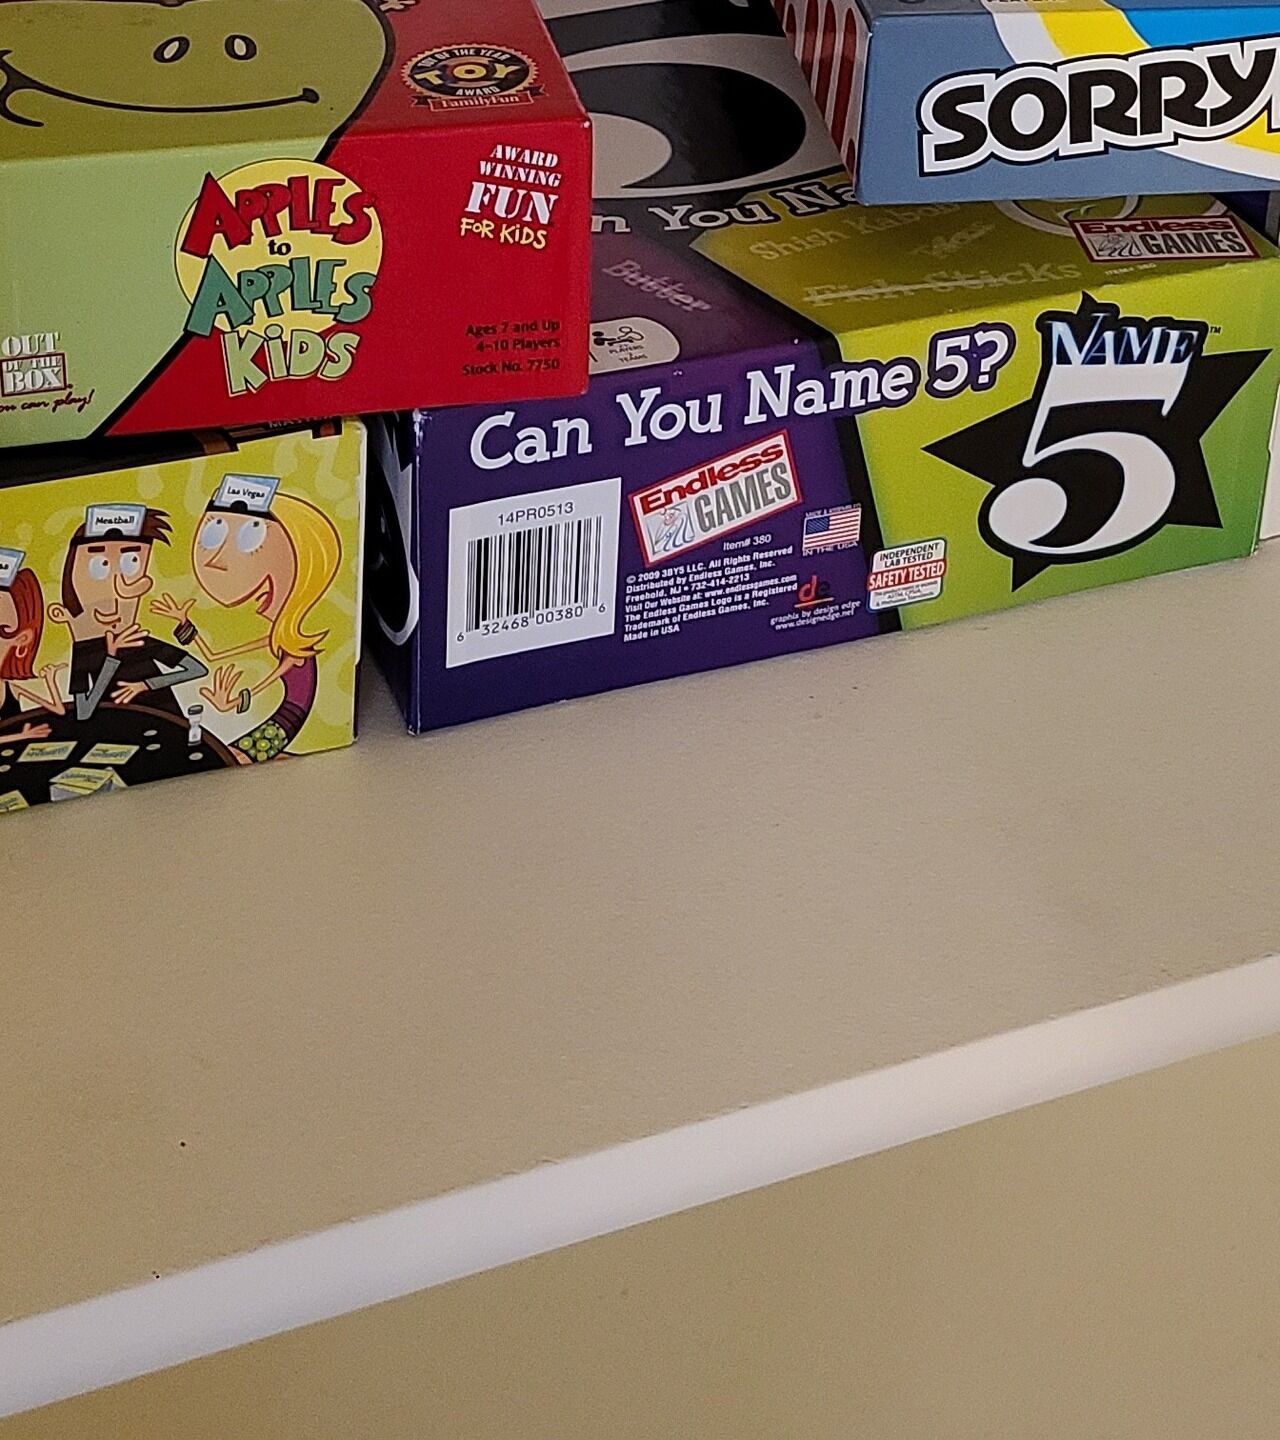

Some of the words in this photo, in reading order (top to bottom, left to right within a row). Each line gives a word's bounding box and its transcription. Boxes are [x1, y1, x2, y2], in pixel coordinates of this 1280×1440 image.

[452, 48, 477, 57] THE
[413, 62, 522, 86] TOY
[440, 95, 521, 109] FamilyFun
[455, 85, 501, 97] AWARD
[489, 144, 559, 169] AWARD
[478, 160, 563, 188] WINNING
[179, 171, 378, 259] APPLES
[464, 180, 560, 226] FUN
[647, 203, 779, 233] You
[1078, 218, 1235, 235] Endless
[267, 239, 292, 256] to
[748, 227, 850, 261] Shish
[1138, 231, 1248, 256] GAMES
[183, 253, 378, 337] APPLES
[465, 323, 498, 339] Ages
[512, 319, 539, 333] and
[541, 318, 561, 334] Up
[1048, 311, 1199, 367] NAME
[0, 331, 61, 357] OUT
[511, 337, 561, 352] Players
[3, 367, 62, 394] BOX
[461, 362, 498, 377] Stock
[20, 400, 50, 411] can
[468, 410, 595, 471] Can
[615, 387, 724, 448] You
[743, 361, 914, 427] Name
[932, 327, 1010, 392] 5?
[987, 362, 1191, 555] 5
[241, 486, 266, 500] Vegas
[639, 442, 786, 518] Endless
[693, 461, 792, 535] GAMES
[95, 514, 136, 527] Meatball
[497, 500, 575, 527] 14PR0513
[752, 533, 772, 546] 380
[879, 541, 941, 562] INDEPENDENT
[637, 569, 661, 582] 2009
[686, 561, 707, 574] LLC.
[722, 553, 752, 570] Rights
[752, 545, 794, 561] Reserved
[884, 559, 902, 569] LAB
[902, 551, 934, 565] TESTED
[625, 578, 675, 594] Distributed
[675, 574, 688, 587] by
[688, 568, 723, 583] Endless
[758, 559, 777, 570] Inc.
[669, 584, 683, 596] NJ
[690, 573, 751, 592] 732-414-2213
[868, 567, 908, 591] SAFETY
[908, 560, 945, 582] TESTED
[624, 601, 644, 614] Visit
[659, 594, 691, 607] Website
[703, 573, 798, 599] www.endlessgames.com
[624, 611, 642, 623] The
[642, 606, 678, 621] Endless
[677, 601, 710, 614] Games
[710, 596, 733, 609] Logo
[750, 582, 799, 600] Registered
[455, 631, 465, 643] 6
[481, 615, 530, 637] 32468
[535, 604, 585, 626] 00380
[597, 602, 607, 614] 6
[623, 616, 671, 633] Trademark
[681, 607, 718, 622] Endless
[752, 598, 770, 608] Inc.
[812, 603, 841, 617] design
[622, 629, 649, 643] Made
[660, 623, 681, 636] USA
